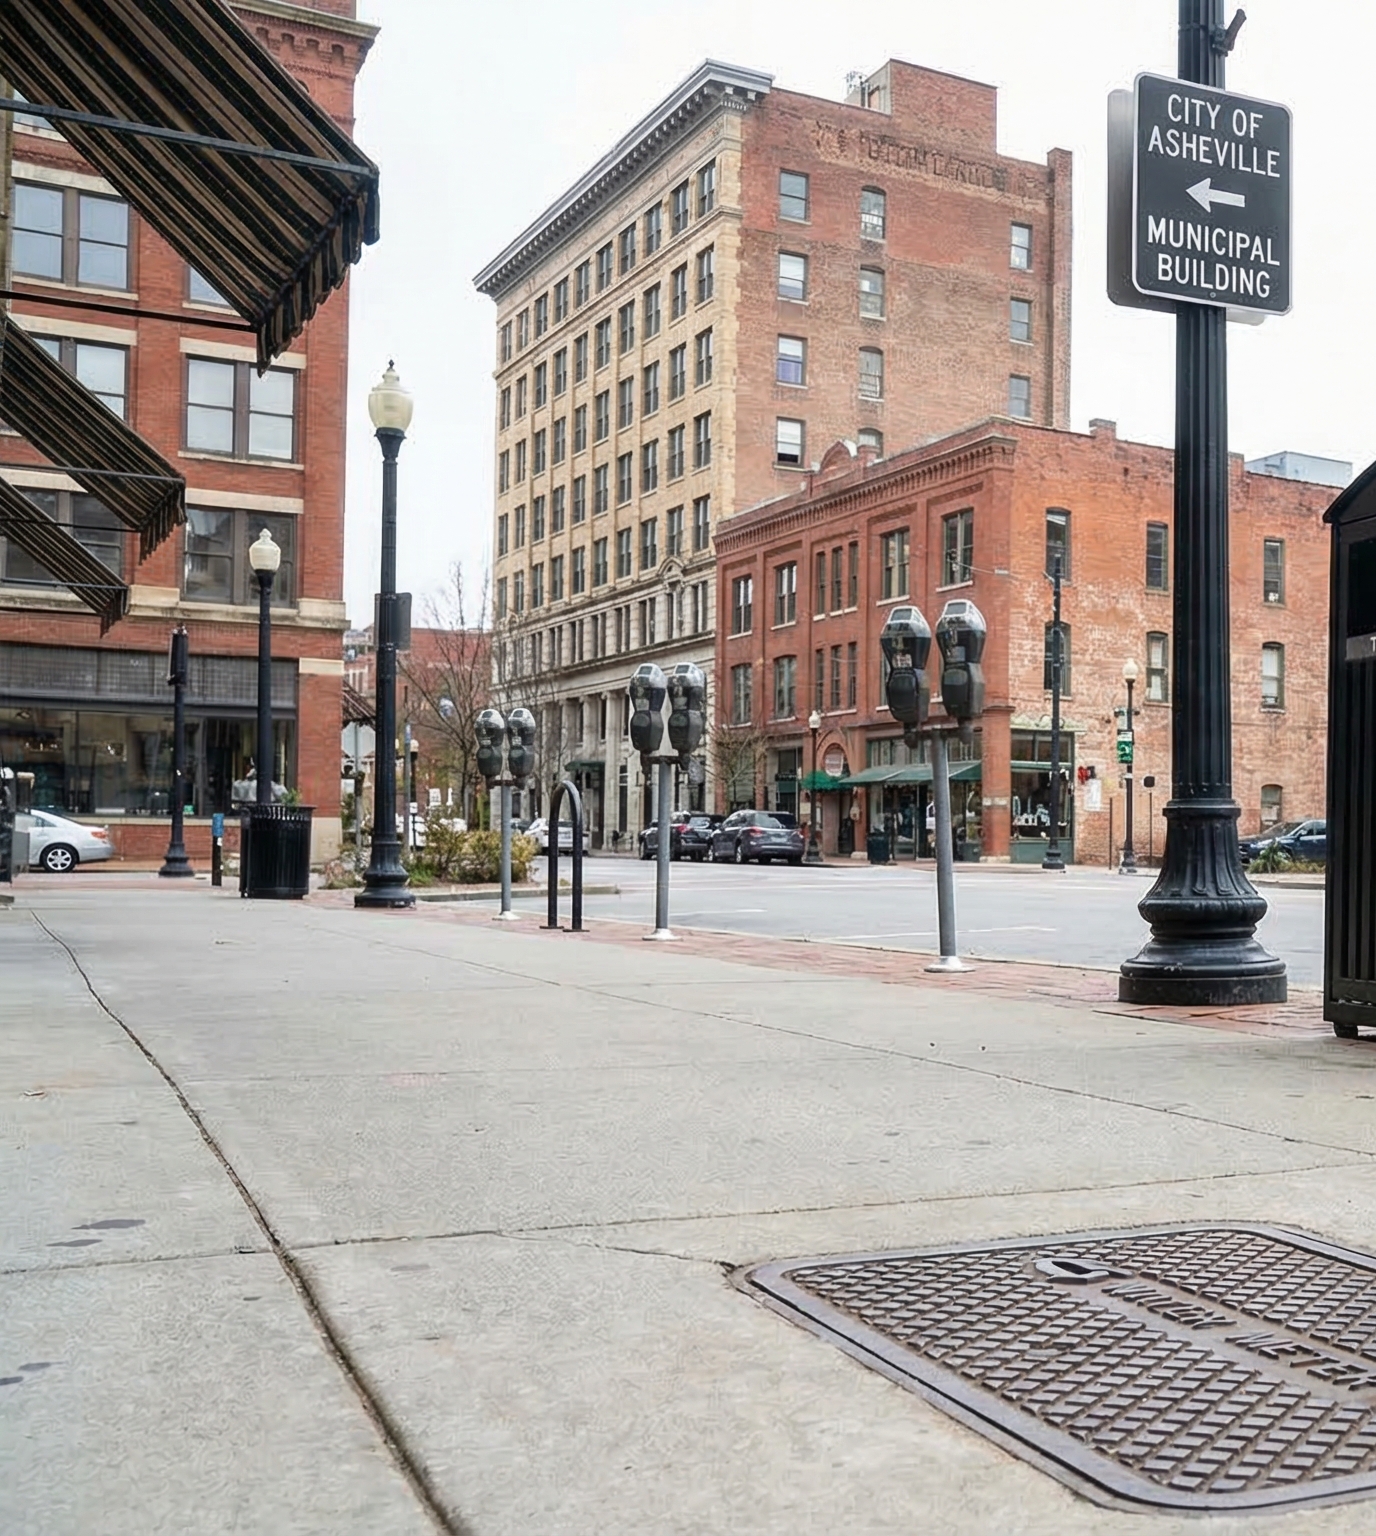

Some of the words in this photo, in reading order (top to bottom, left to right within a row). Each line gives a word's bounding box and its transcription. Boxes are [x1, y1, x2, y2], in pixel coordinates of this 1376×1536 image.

[1168, 94, 1221, 130] CITY
[1232, 109, 1263, 139] OF
[1148, 125, 1280, 178] ASHEVILLE
[1148, 215, 1280, 266] MUNICIPAL
[1158, 253, 1270, 298] BUILDING
